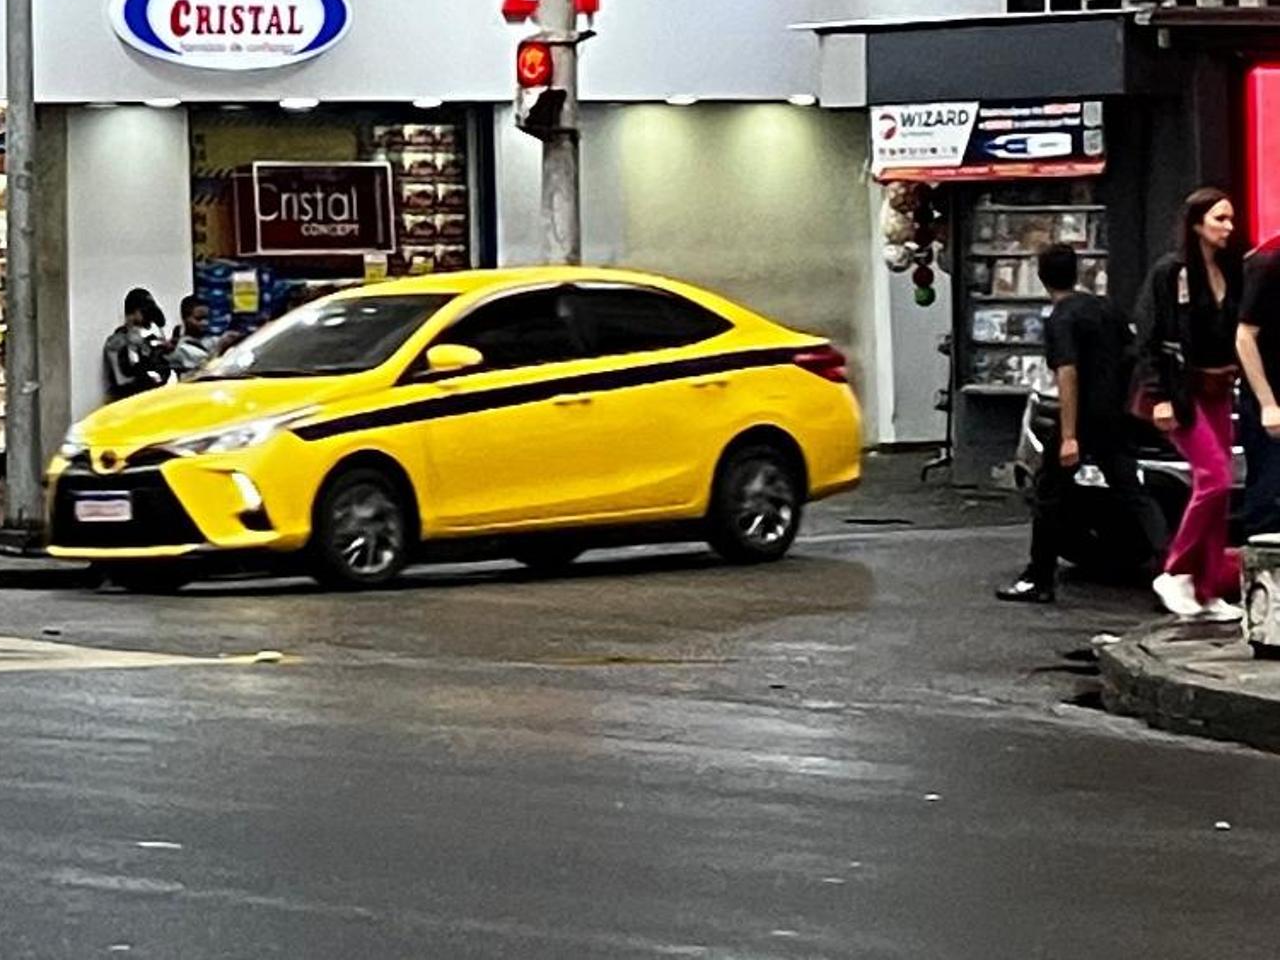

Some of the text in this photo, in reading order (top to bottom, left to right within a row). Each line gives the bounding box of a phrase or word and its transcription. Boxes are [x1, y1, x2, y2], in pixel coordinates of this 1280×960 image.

[900, 108, 969, 128] WIZARD
[258, 181, 358, 222] Cristal
[300, 223, 360, 236] CONCEPT
